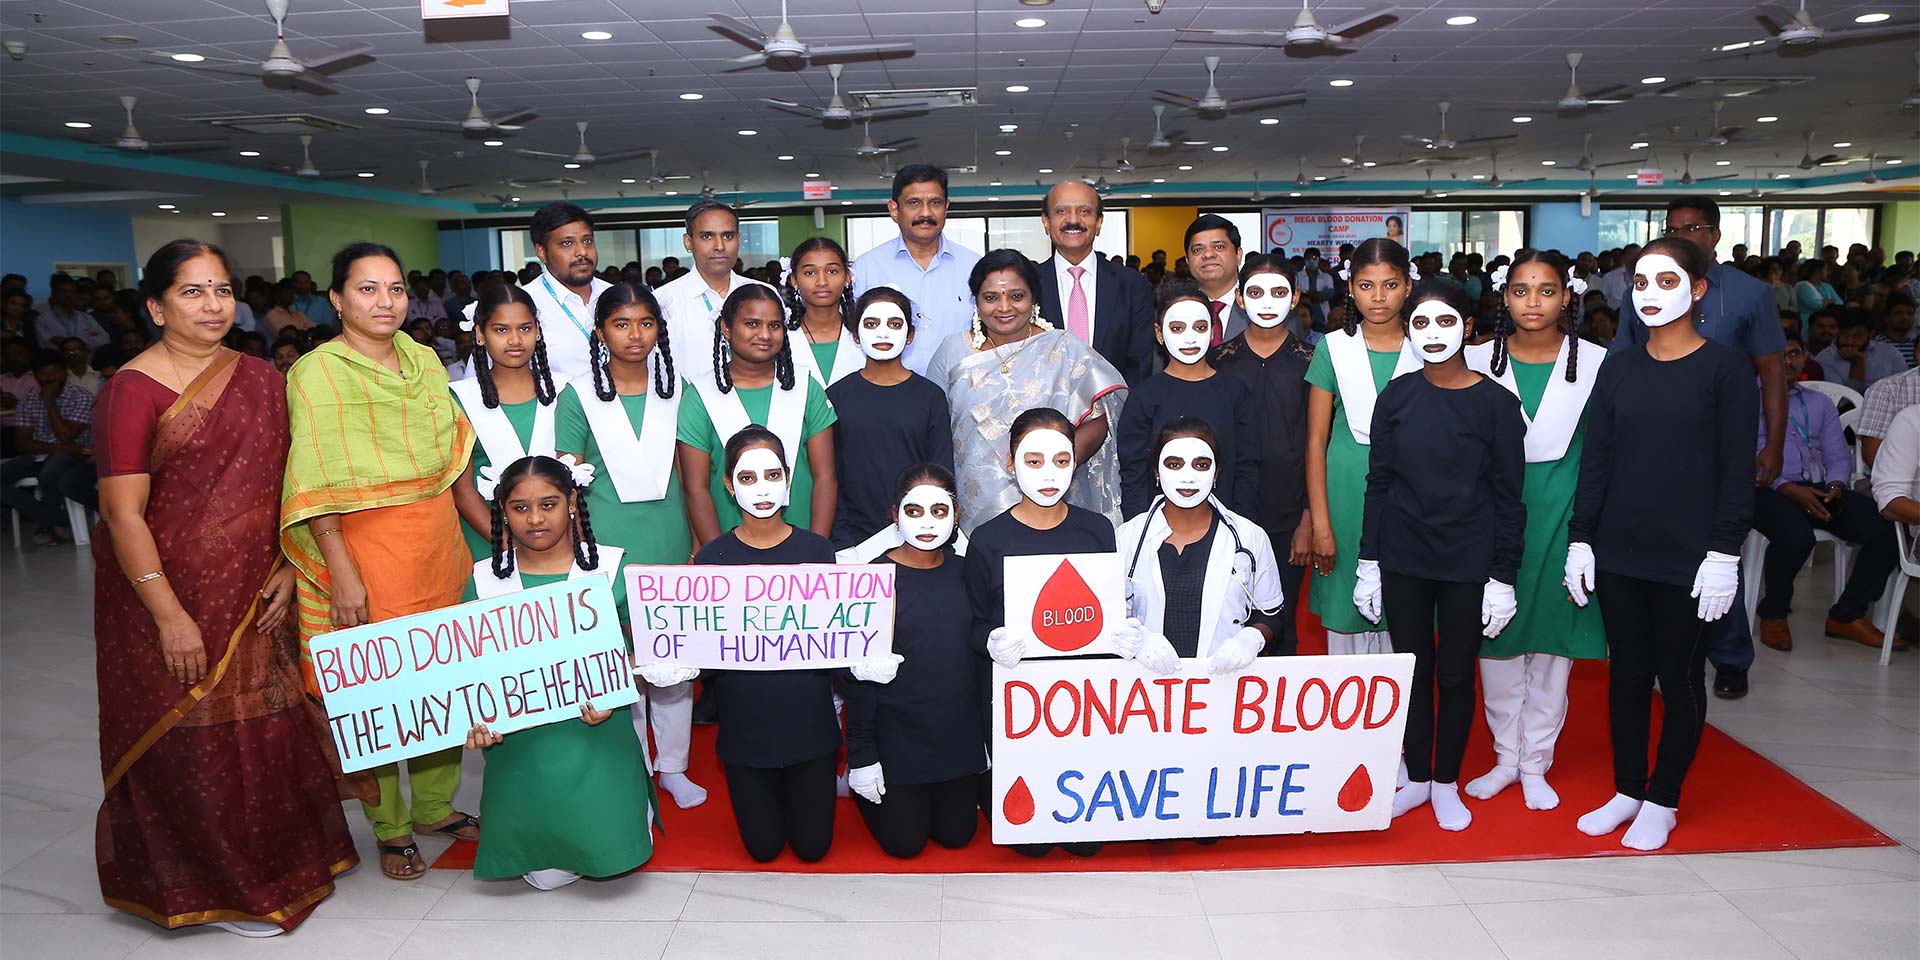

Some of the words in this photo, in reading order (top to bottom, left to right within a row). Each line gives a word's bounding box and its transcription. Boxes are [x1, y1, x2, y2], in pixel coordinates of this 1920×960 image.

[1294, 215, 1316, 223] MEGA
[1318, 215, 1344, 223] BLOOD
[1345, 215, 1384, 223] DONATION
[1328, 225, 1350, 233] CAMP
[638, 574, 731, 602] BLOOD
[745, 572, 893, 602] DONATION
[644, 605, 668, 631] IS
[673, 605, 727, 632] THE
[743, 604, 819, 632] REAL
[826, 602, 877, 629] ACT
[1043, 605, 1096, 628] BLOOD
[316, 636, 402, 693] BLOOD
[408, 596, 559, 672] DONATION
[567, 588, 598, 635] IS
[653, 634, 687, 660] OF
[720, 630, 879, 662] HUMANITY
[329, 705, 392, 760] THE
[393, 690, 453, 747] WAY
[455, 682, 498, 729] TO
[501, 669, 544, 719] BE
[543, 646, 631, 710] HEALTHY
[1004, 678, 1211, 740] DONATE
[1233, 675, 1400, 735] BLOOD
[1051, 767, 1185, 825] SAVE
[1206, 763, 1310, 821] LIFE
